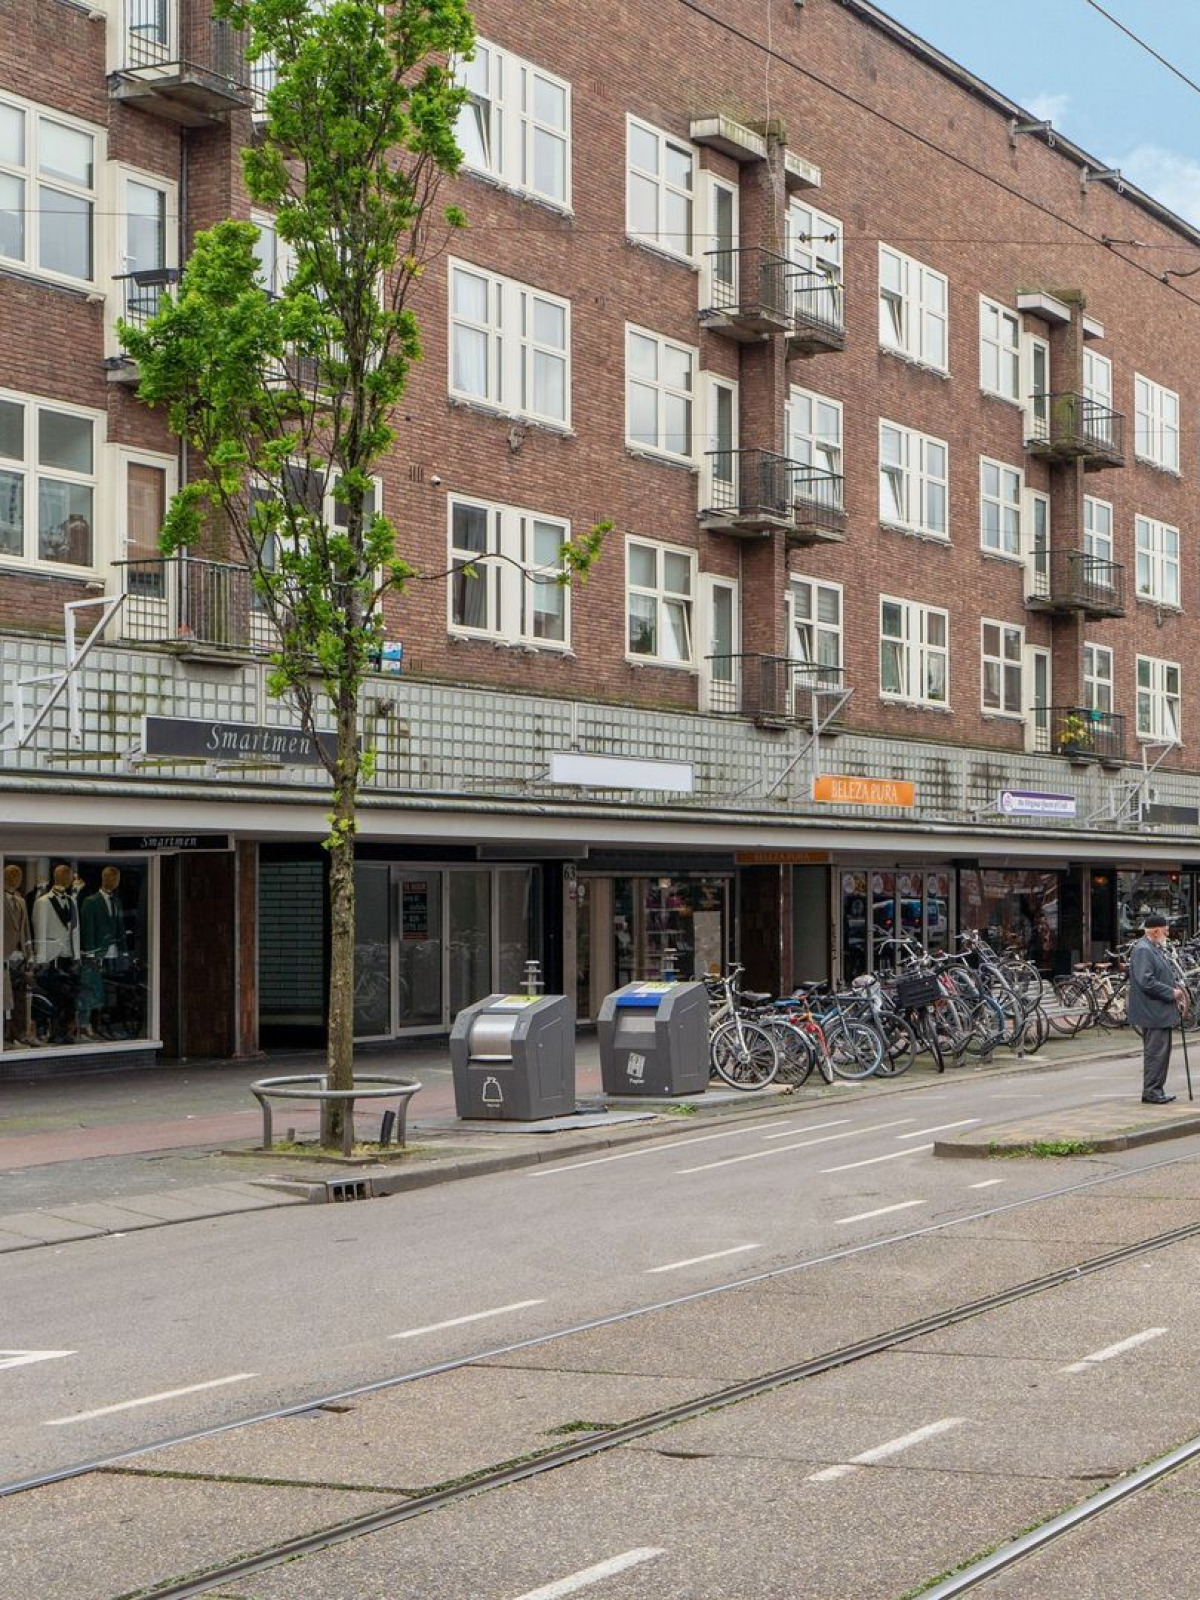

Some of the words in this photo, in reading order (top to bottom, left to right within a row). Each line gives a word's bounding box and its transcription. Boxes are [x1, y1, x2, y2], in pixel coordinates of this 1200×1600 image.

[206, 724, 311, 755] Smartmen
[831, 780, 868, 799] BELEZA
[869, 783, 899, 802] PURA
[140, 834, 198, 848] Smartmen
